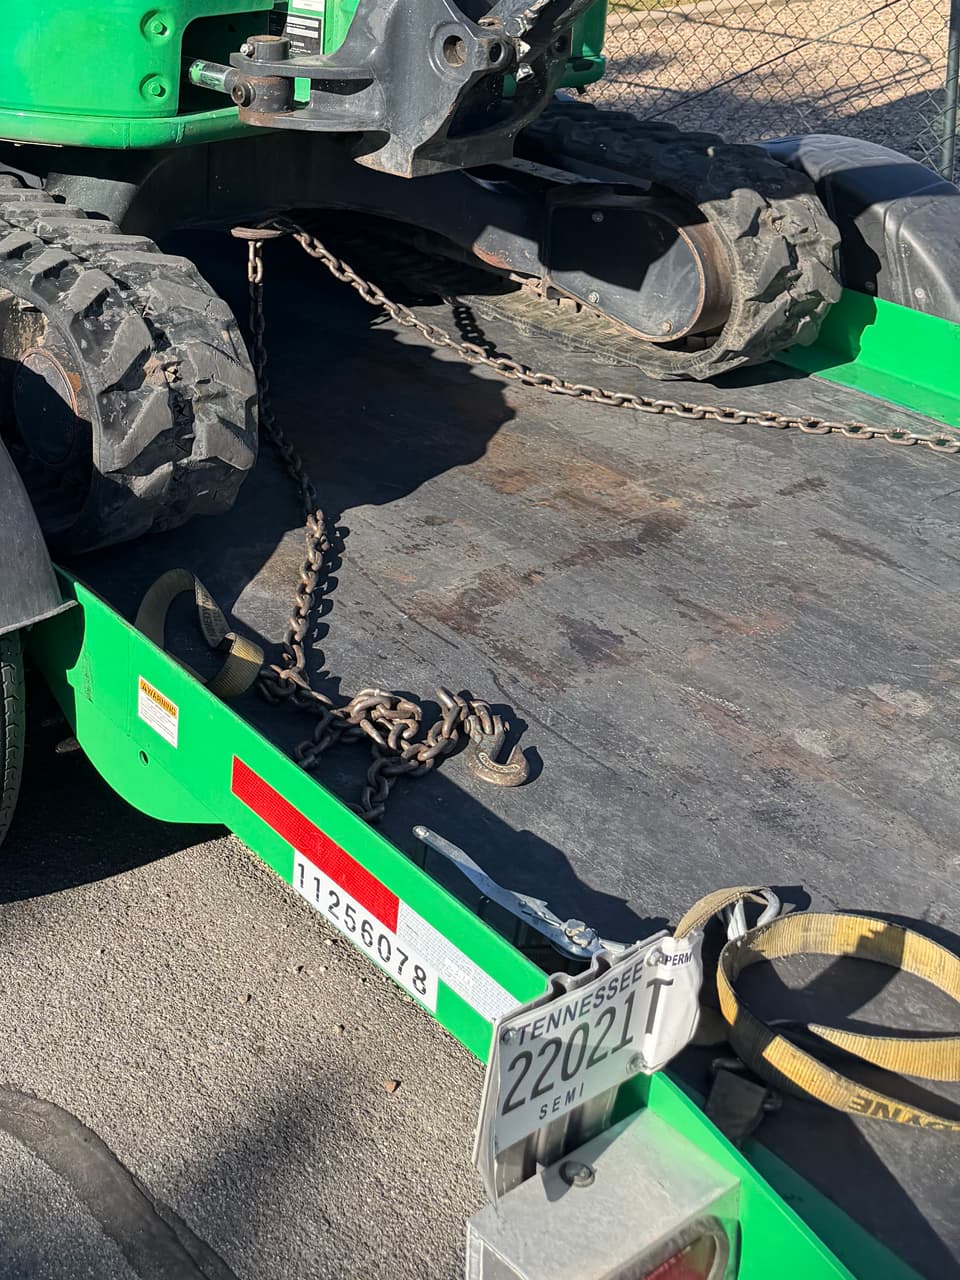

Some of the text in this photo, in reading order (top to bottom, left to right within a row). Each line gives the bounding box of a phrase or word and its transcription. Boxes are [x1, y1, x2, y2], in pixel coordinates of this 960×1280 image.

[297, 862, 427, 996] 11256078
[517, 951, 693, 1045] TENNESSEE PERM
[539, 1082, 585, 1120] SEMI
